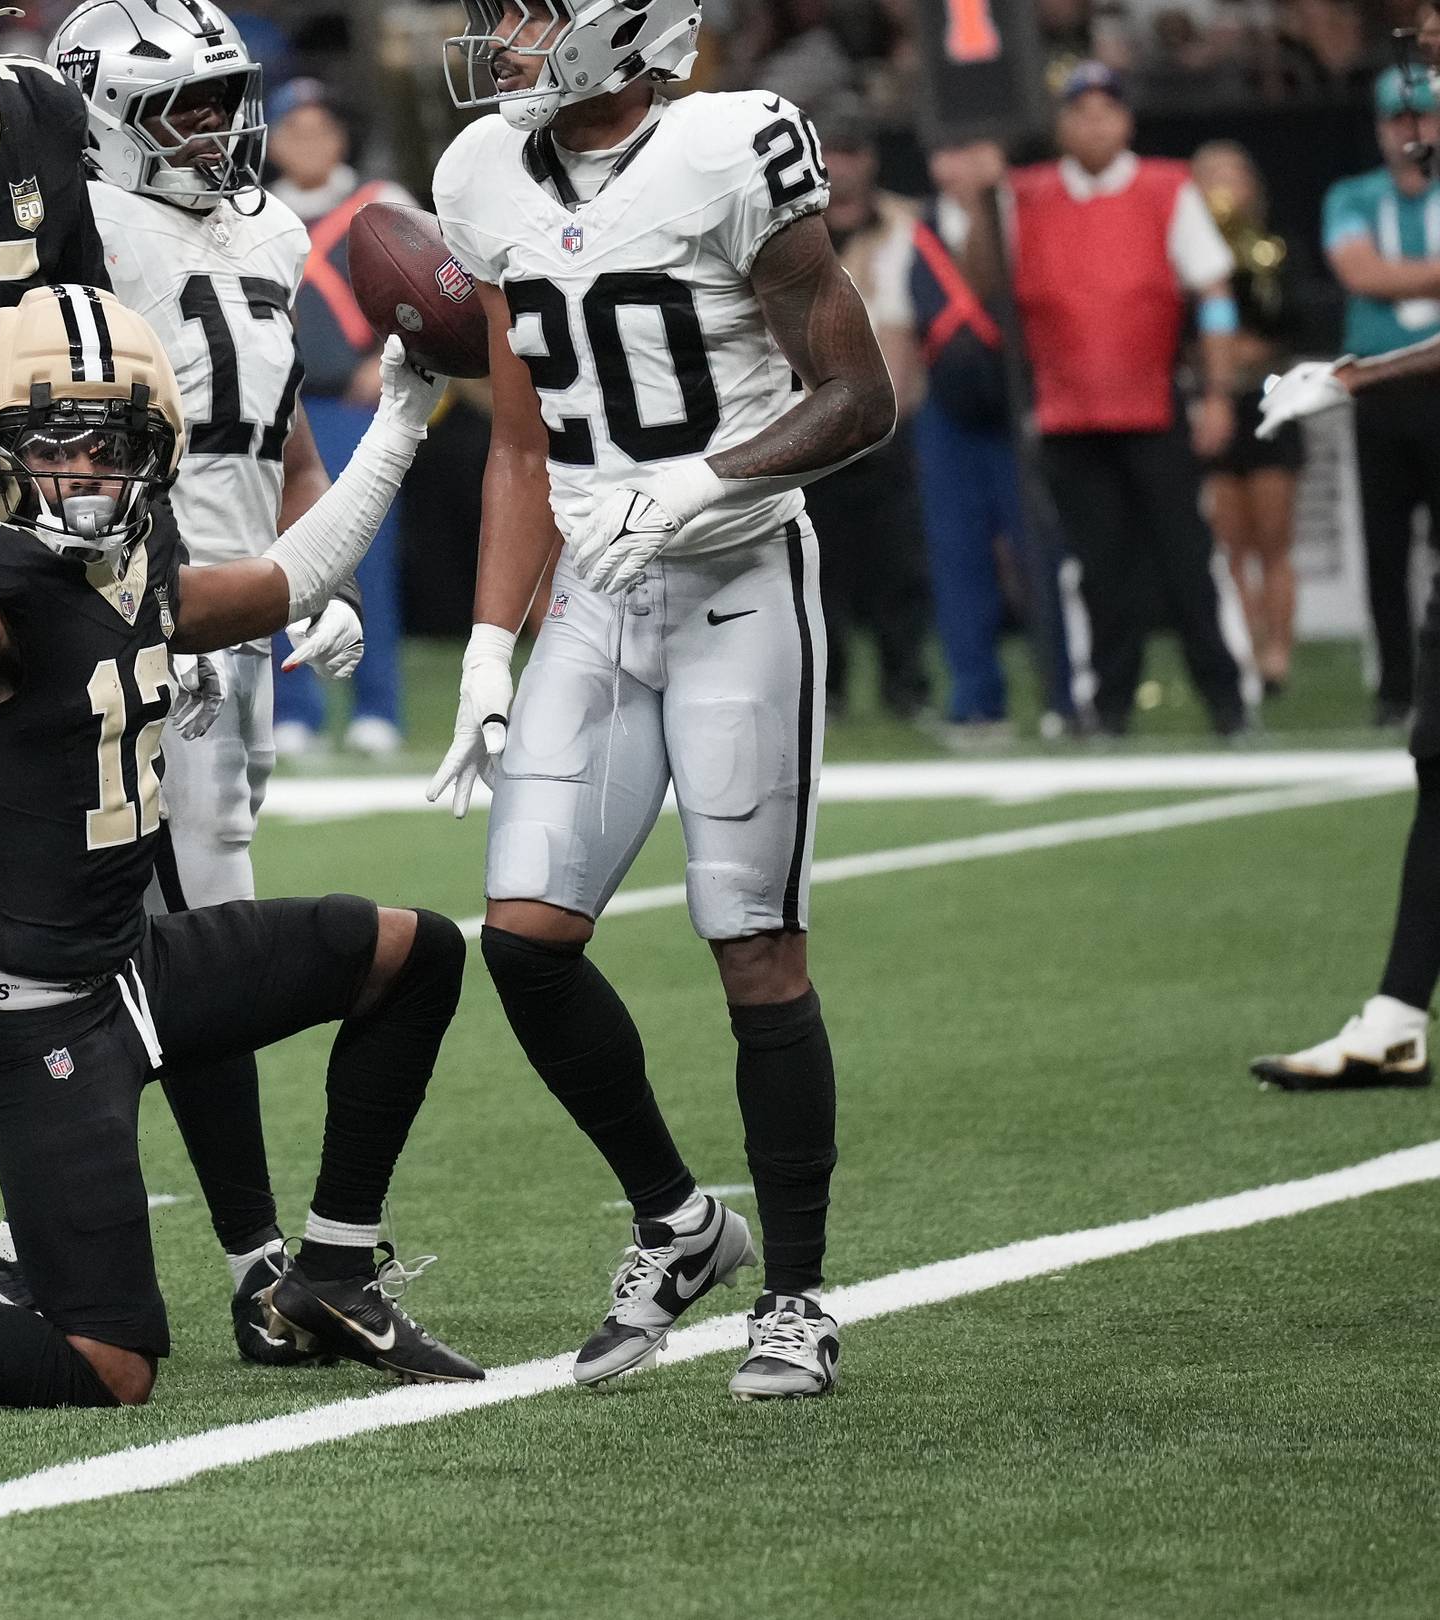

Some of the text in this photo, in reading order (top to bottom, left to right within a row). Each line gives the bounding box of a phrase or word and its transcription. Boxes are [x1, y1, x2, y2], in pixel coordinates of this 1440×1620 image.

[60, 52, 96, 63] RAIDERS
[204, 50, 239, 63] RAIDERS
[17, 201, 42, 221] 60
[440, 263, 469, 298] NFL
[175, 271, 305, 462] 17
[504, 272, 724, 467] 20
[86, 643, 179, 851] 12
